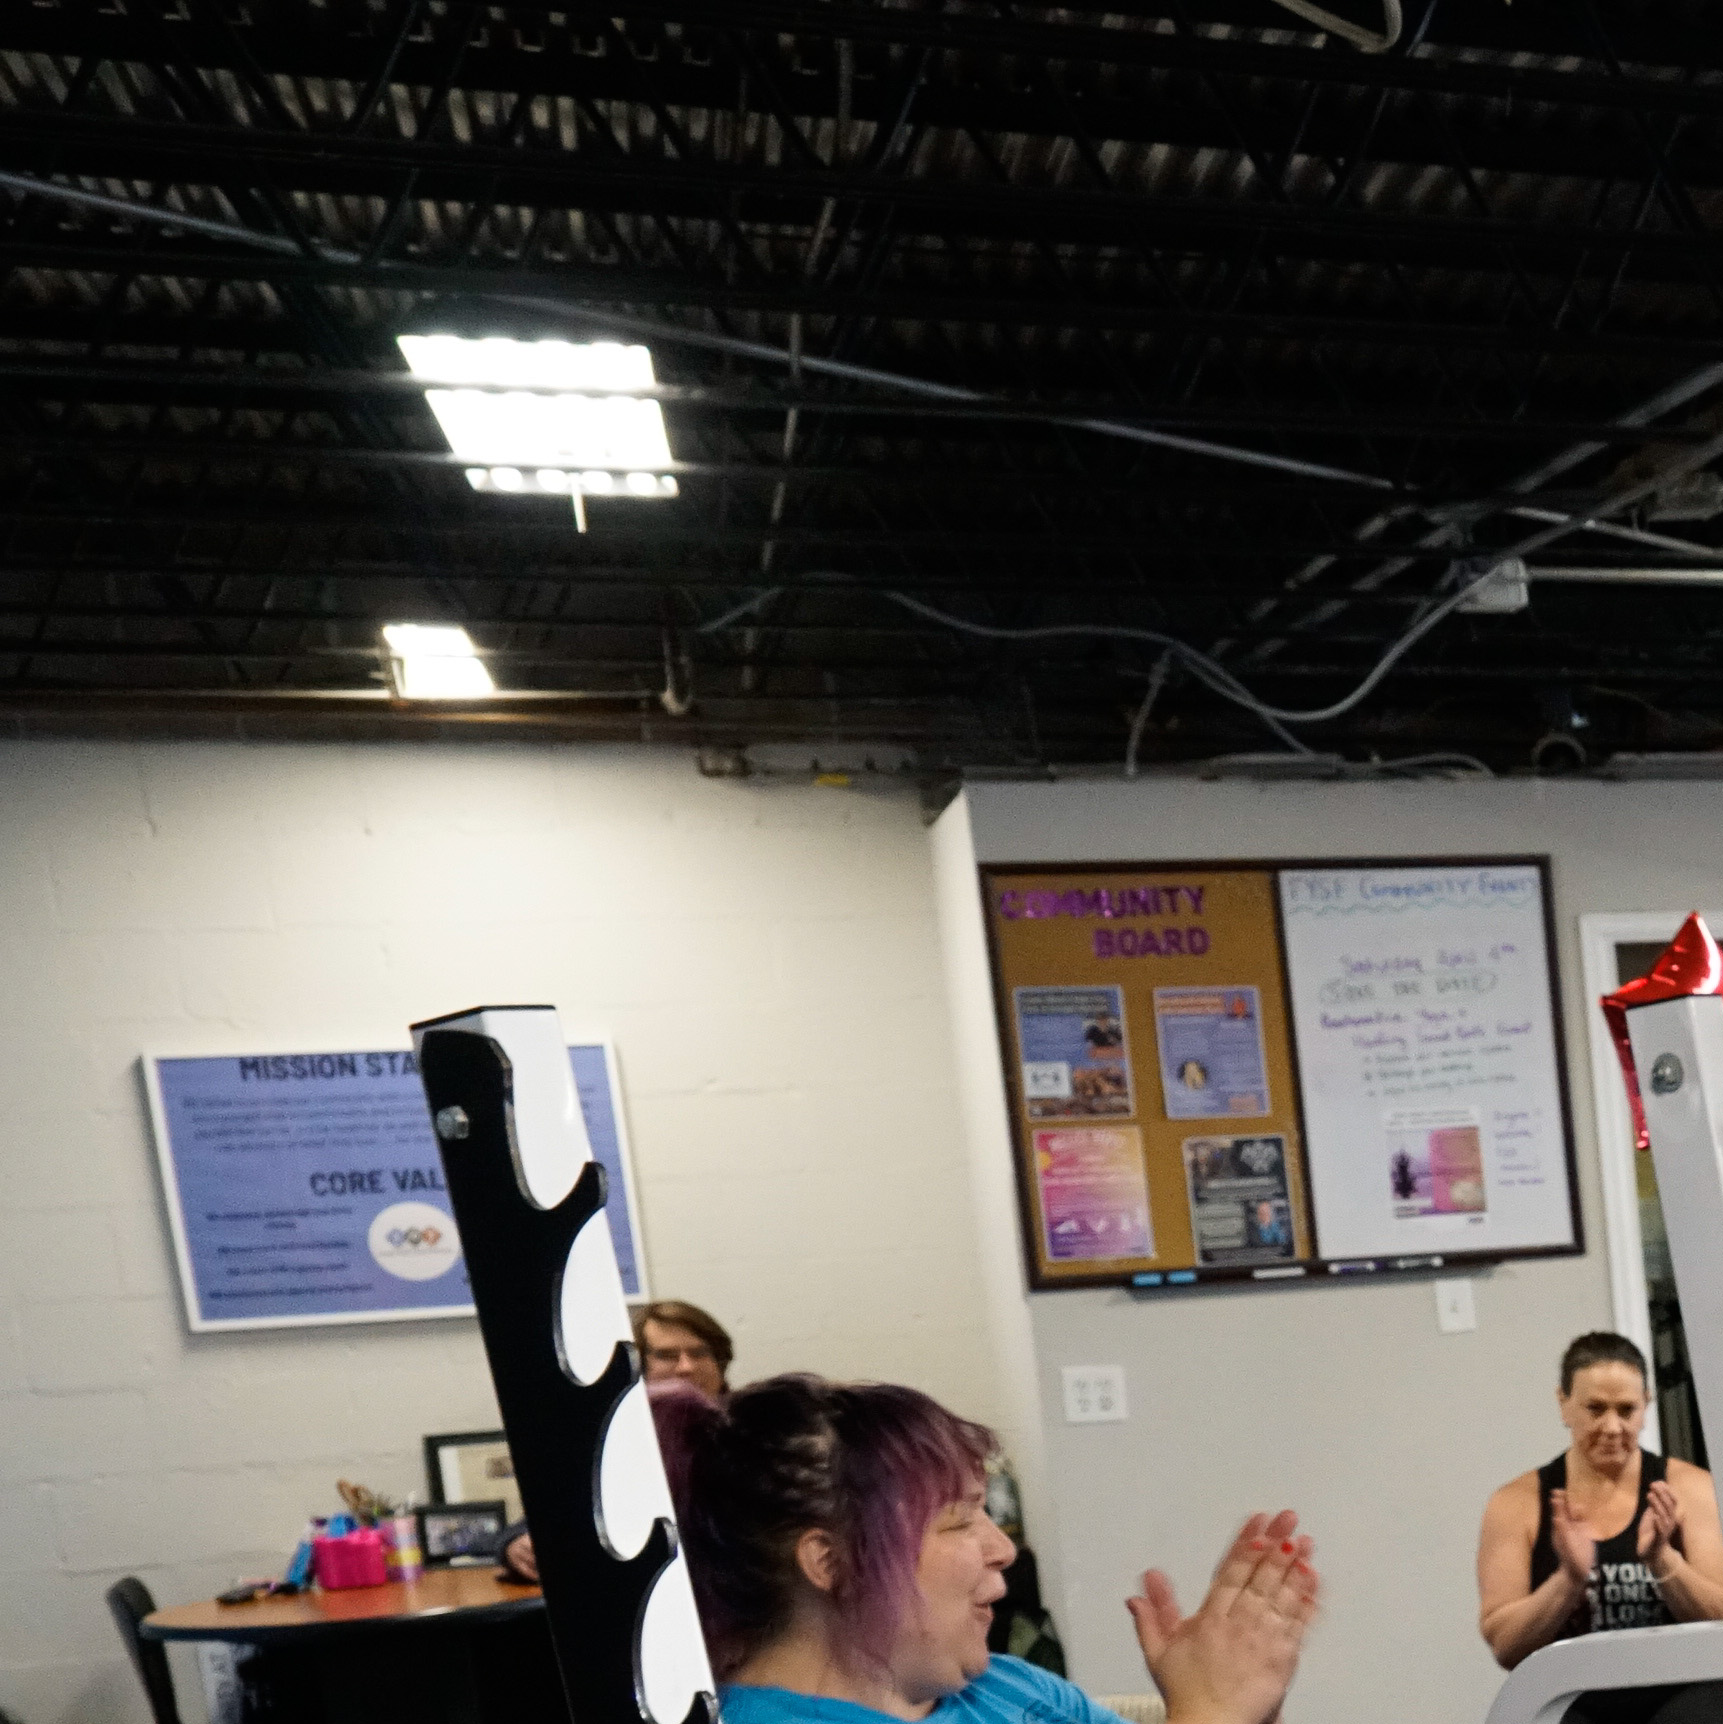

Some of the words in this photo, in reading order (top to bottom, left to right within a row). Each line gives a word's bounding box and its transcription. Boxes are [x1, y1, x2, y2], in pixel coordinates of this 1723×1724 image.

[1000, 884, 1204, 919] COMMUNITY
[1093, 926, 1210, 958] BOARD
[239, 1054, 357, 1082] MISSION
[309, 1170, 386, 1197] CORE
